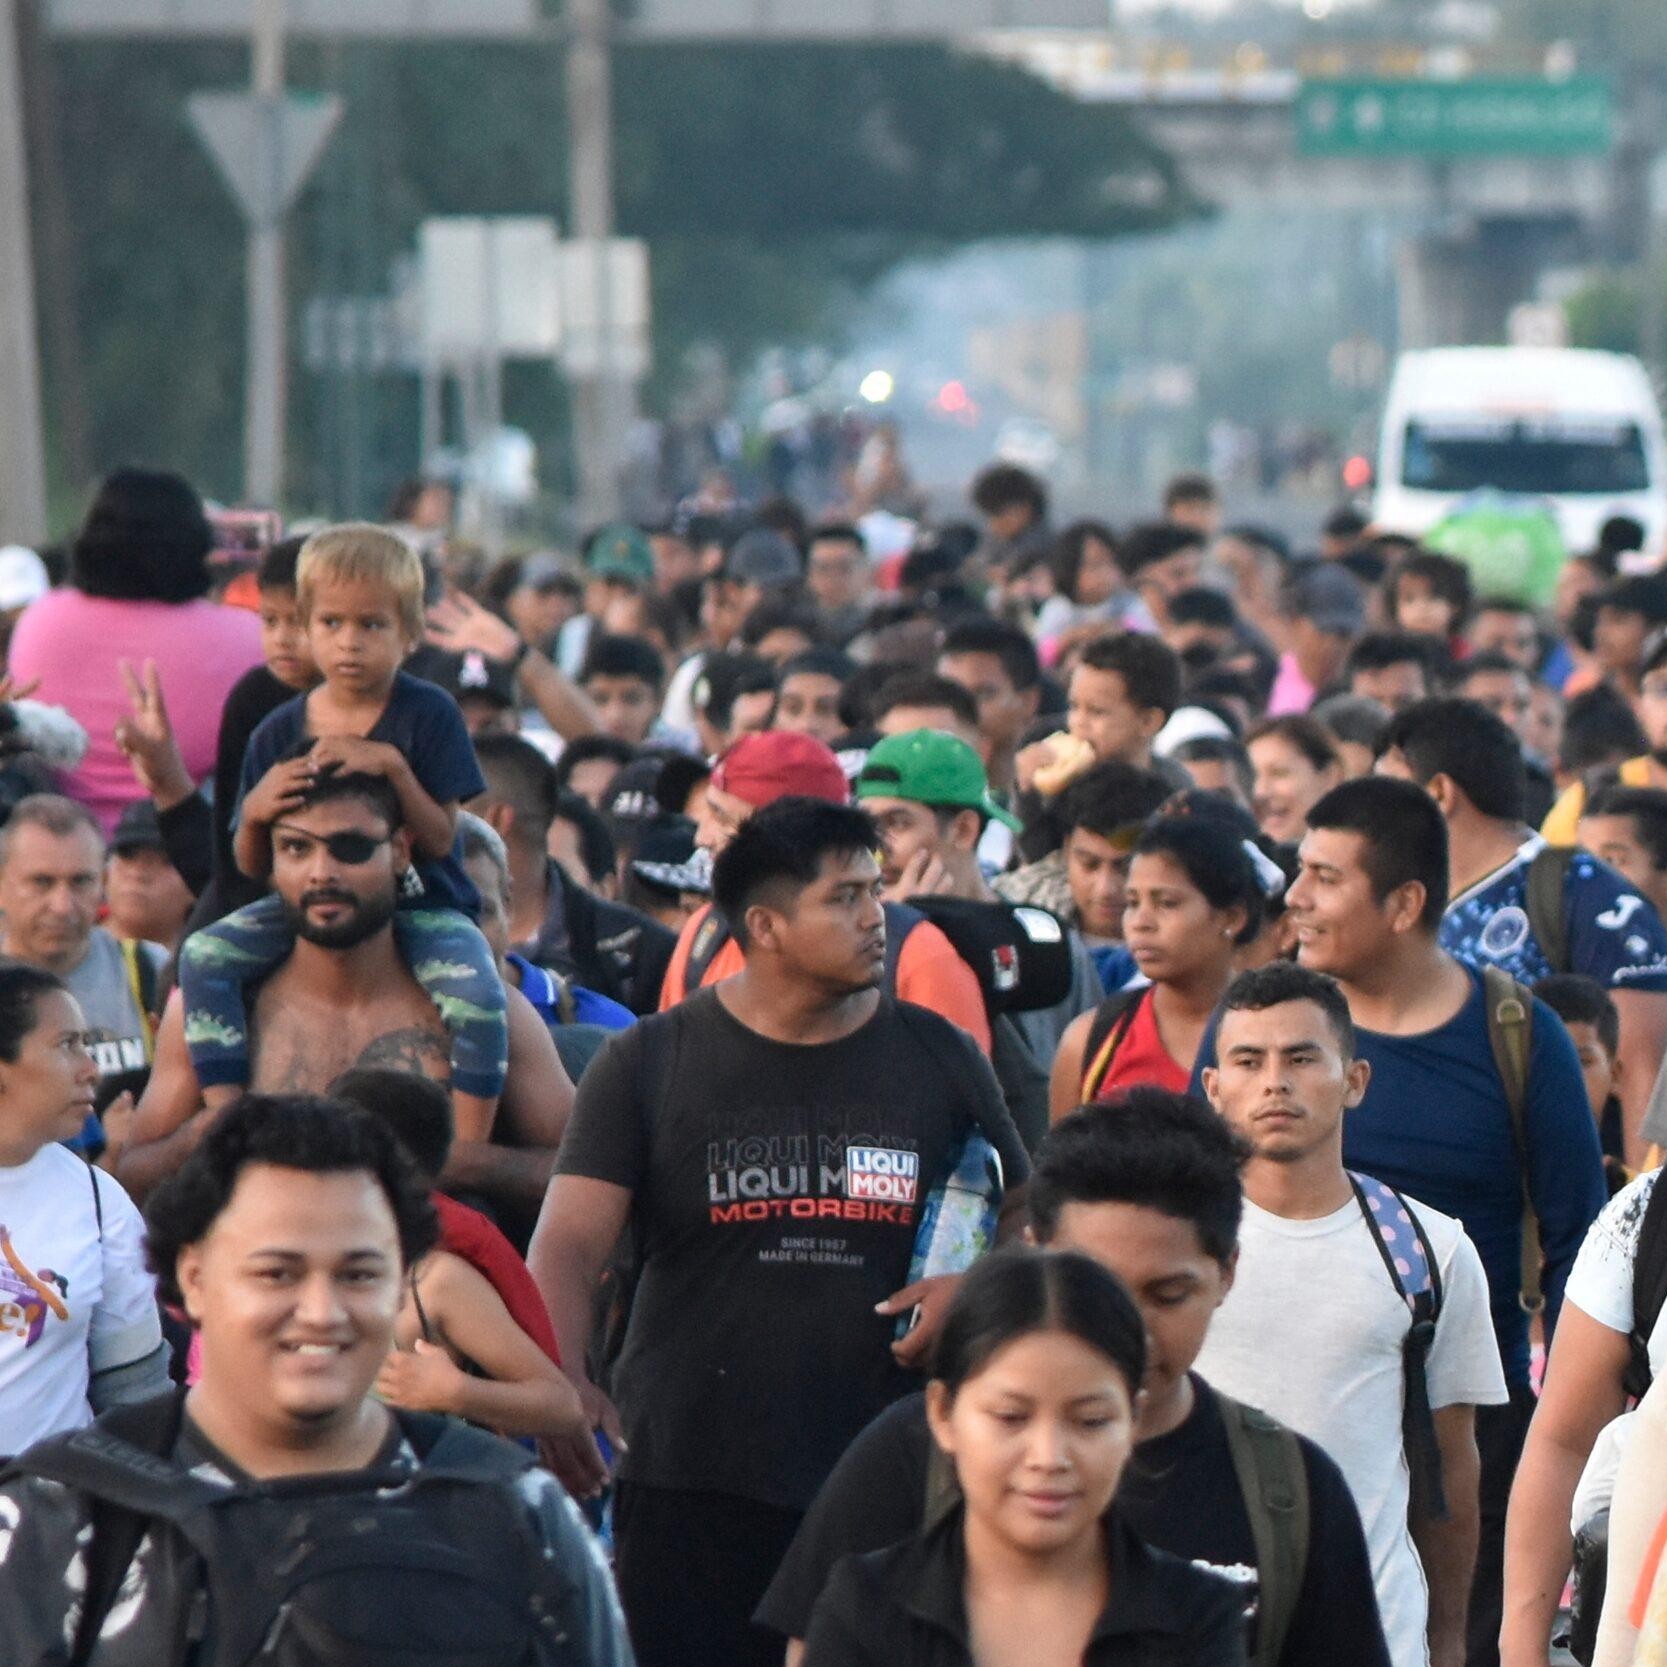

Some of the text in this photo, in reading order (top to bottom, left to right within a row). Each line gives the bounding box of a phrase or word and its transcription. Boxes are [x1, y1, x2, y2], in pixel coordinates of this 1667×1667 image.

[851, 1150, 915, 1175] LIQUI
[708, 1165, 808, 1202] LIQUI
[851, 1176, 915, 1201] MOLY
[709, 1198, 914, 1225] MOTORBIKE
[780, 1236, 816, 1250] SINCE
[758, 1249, 865, 1266] MADE IN GERMANY
